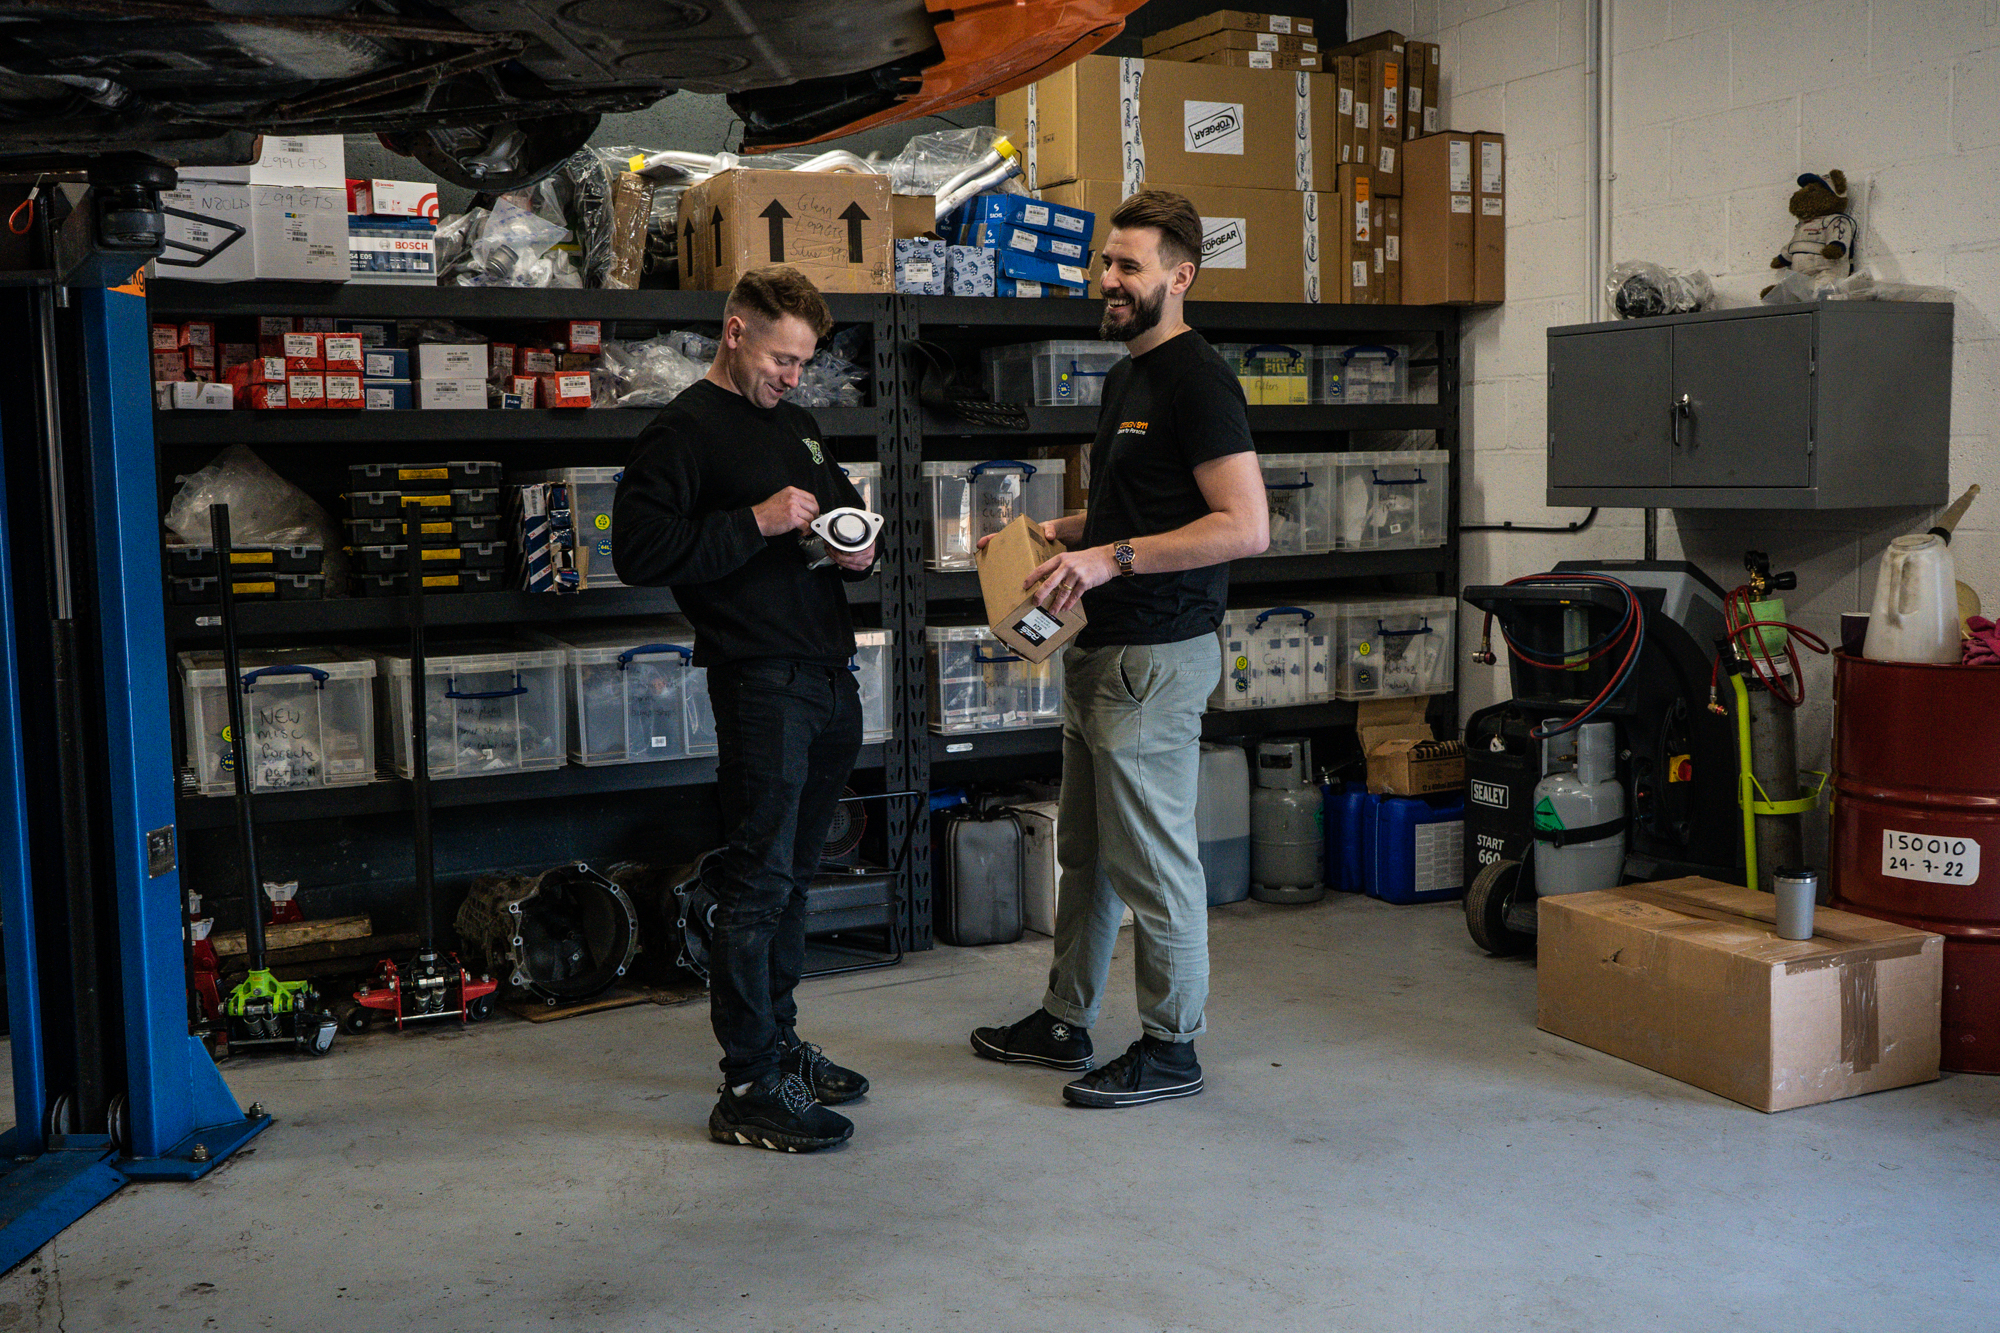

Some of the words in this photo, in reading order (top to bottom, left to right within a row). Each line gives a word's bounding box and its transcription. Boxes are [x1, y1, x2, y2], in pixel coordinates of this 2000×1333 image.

[1194, 118, 1230, 140] TOPGEAR
[395, 241, 428, 250] BOSCH
[1202, 230, 1237, 252] TOPGEAR
[1265, 363, 1304, 374] FILTER
[260, 707, 301, 726] NEW
[1473, 783, 1505, 805] SEALEY
[1476, 834, 1505, 851] START
[1889, 833, 1966, 856] 150010
